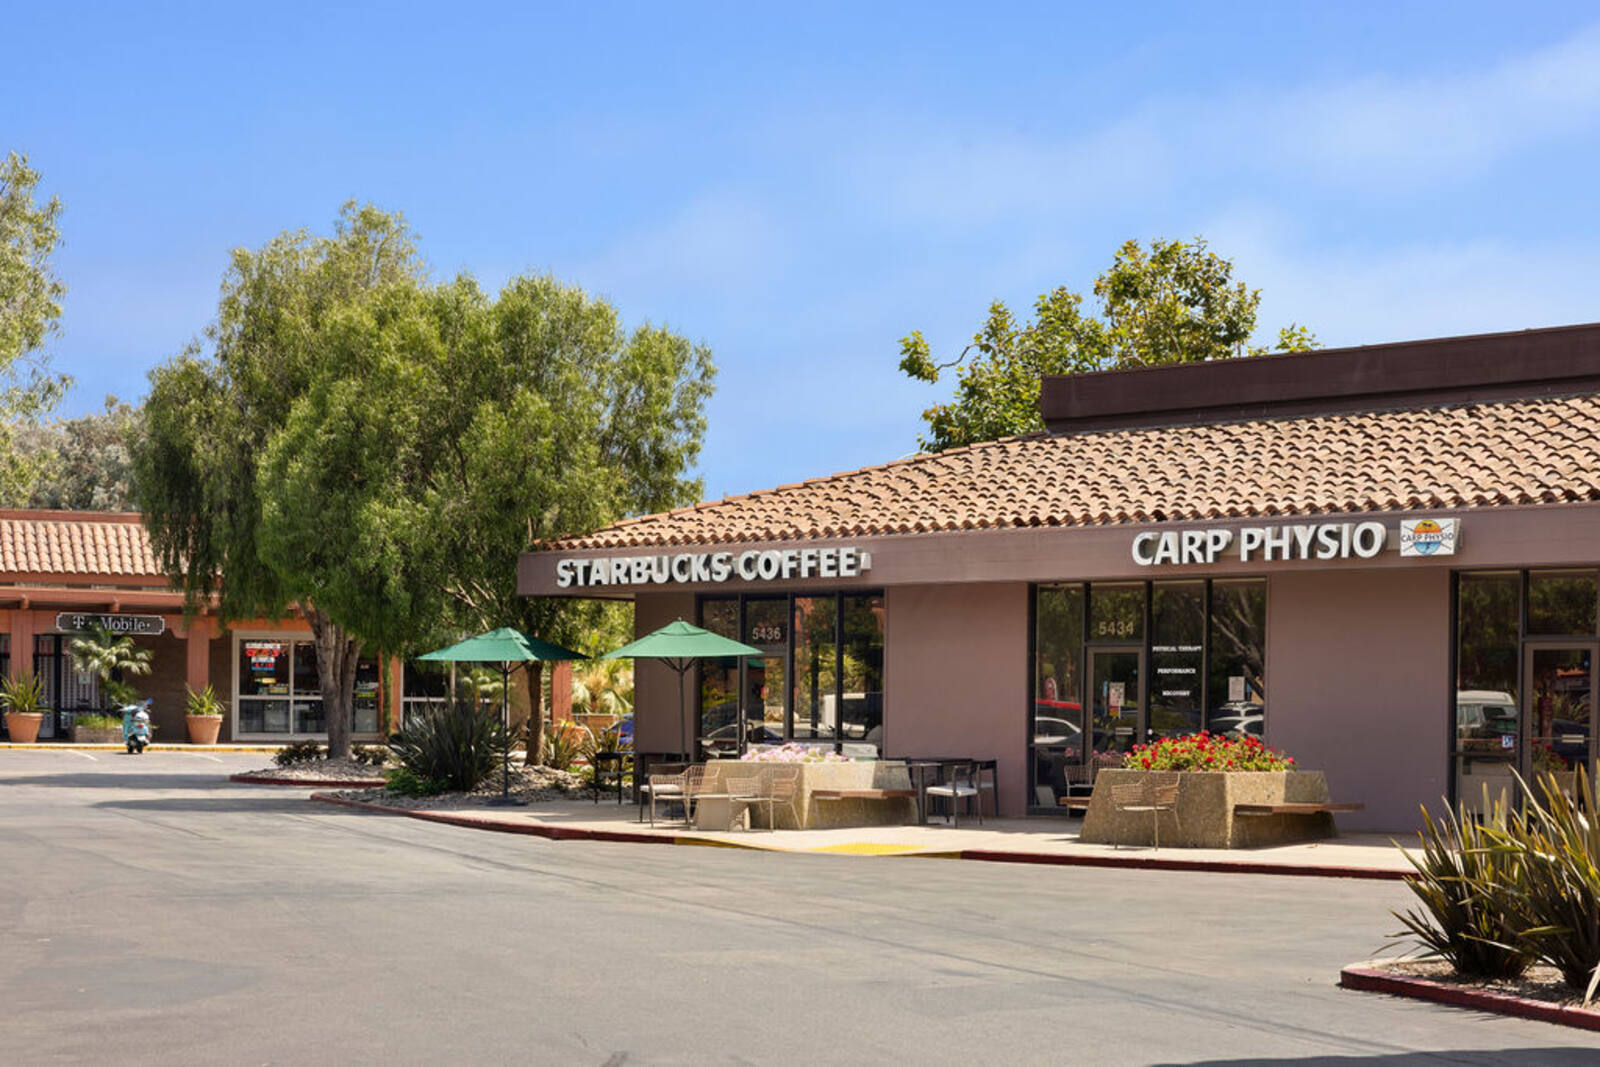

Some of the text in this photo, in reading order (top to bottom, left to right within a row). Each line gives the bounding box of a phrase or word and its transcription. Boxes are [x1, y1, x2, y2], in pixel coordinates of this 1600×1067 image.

[1132, 522, 1385, 565] CARP PHYSIO
[1400, 532, 1454, 543] CARP PHYSIO
[556, 547, 859, 587] STARBUCKS COFFEE
[751, 627, 781, 640] 5436
[1099, 621, 1134, 635] 5434
